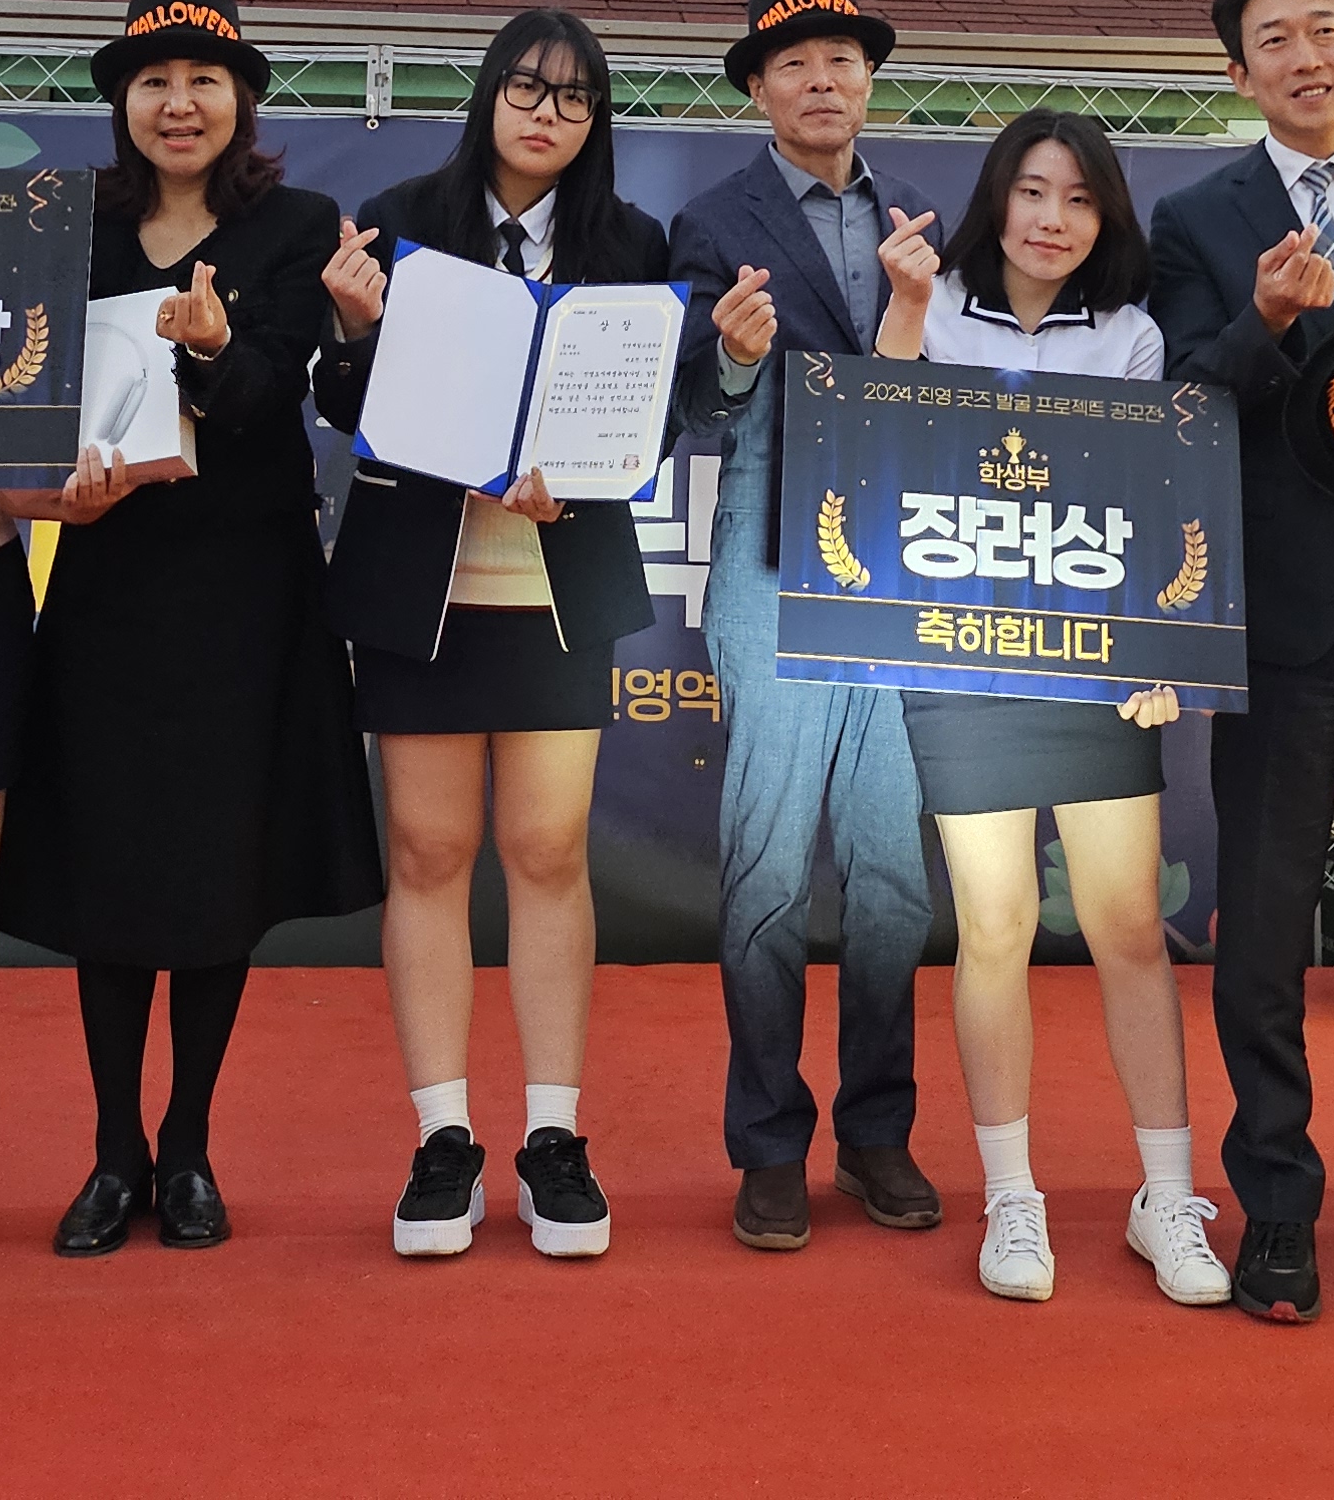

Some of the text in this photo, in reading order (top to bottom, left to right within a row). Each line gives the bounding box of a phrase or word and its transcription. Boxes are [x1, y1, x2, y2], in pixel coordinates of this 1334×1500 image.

[862, 382, 1163, 424] 2024 진영 굿즈 발굴 프로젝트 공모전
[978, 460, 1051, 493] 학생부
[898, 490, 1134, 591] 장려상
[915, 607, 1114, 665] 축하합니다
[611, 667, 721, 723] 영역
